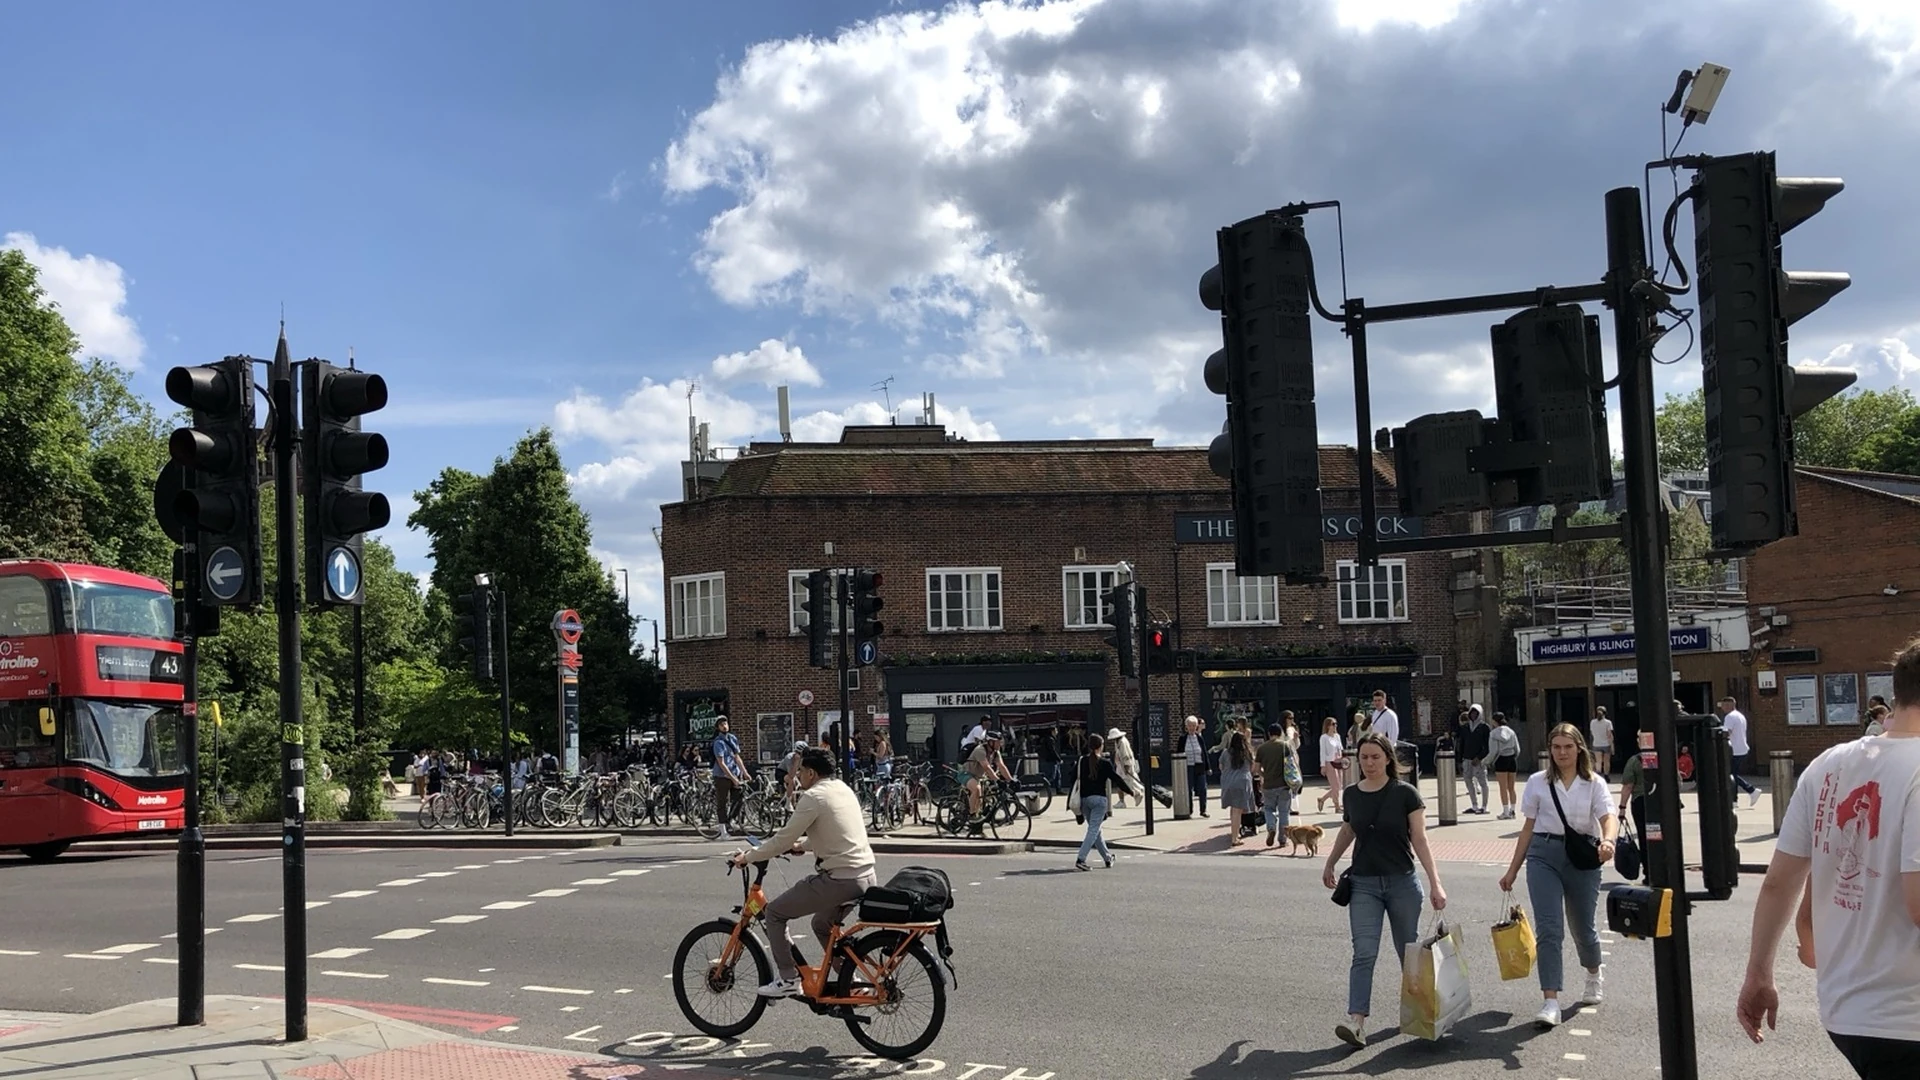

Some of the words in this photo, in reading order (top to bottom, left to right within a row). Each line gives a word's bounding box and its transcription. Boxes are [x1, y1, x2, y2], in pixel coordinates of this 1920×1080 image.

[1193, 520, 1235, 537] THE
[1345, 516, 1409, 535] CCK
[1541, 642, 1586, 655] HIGHBURY
[1589, 643, 1596, 651] &
[1600, 638, 1636, 650] ISLINGT
[0, 655, 39, 669] troline
[161, 656, 178, 675] 43
[936, 695, 953, 706] THE
[956, 694, 992, 705] FAMOUS
[1039, 692, 1058, 703] BAR
[564, 1025, 773, 1057] LOOK
